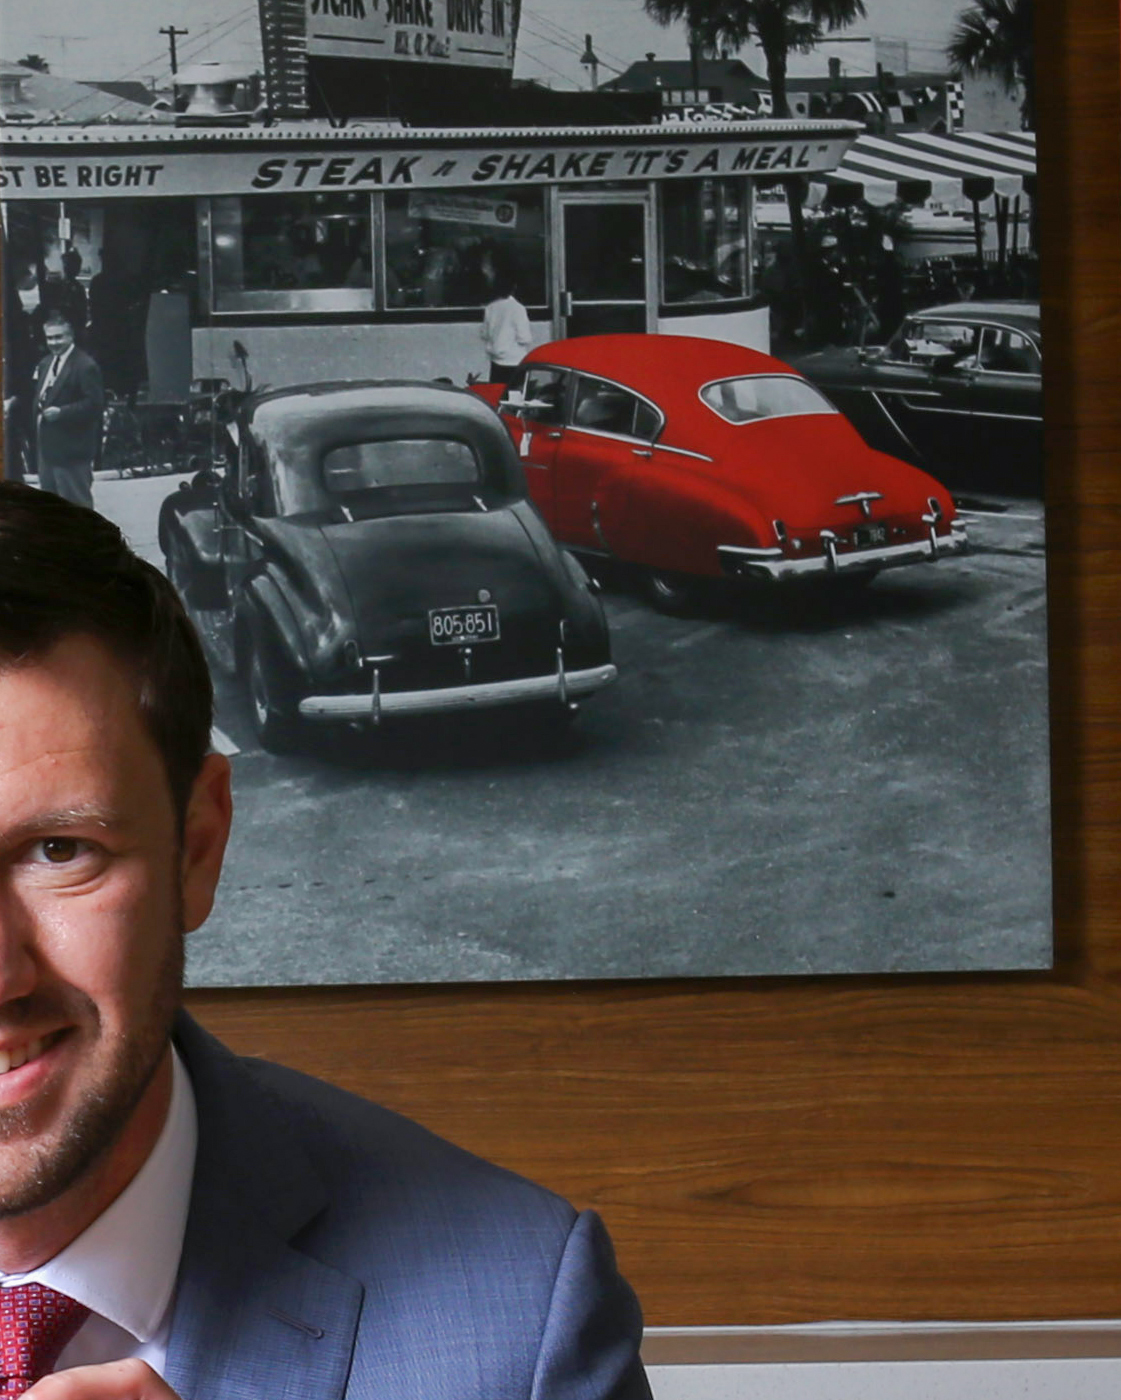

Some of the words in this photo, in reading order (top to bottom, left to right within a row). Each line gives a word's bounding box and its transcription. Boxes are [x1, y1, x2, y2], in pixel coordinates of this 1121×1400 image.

[34, 166, 68, 188] BE
[77, 164, 164, 187] RIGHT
[251, 156, 422, 189] STEAK
[471, 151, 615, 182] SHAKE
[694, 148, 720, 172] A
